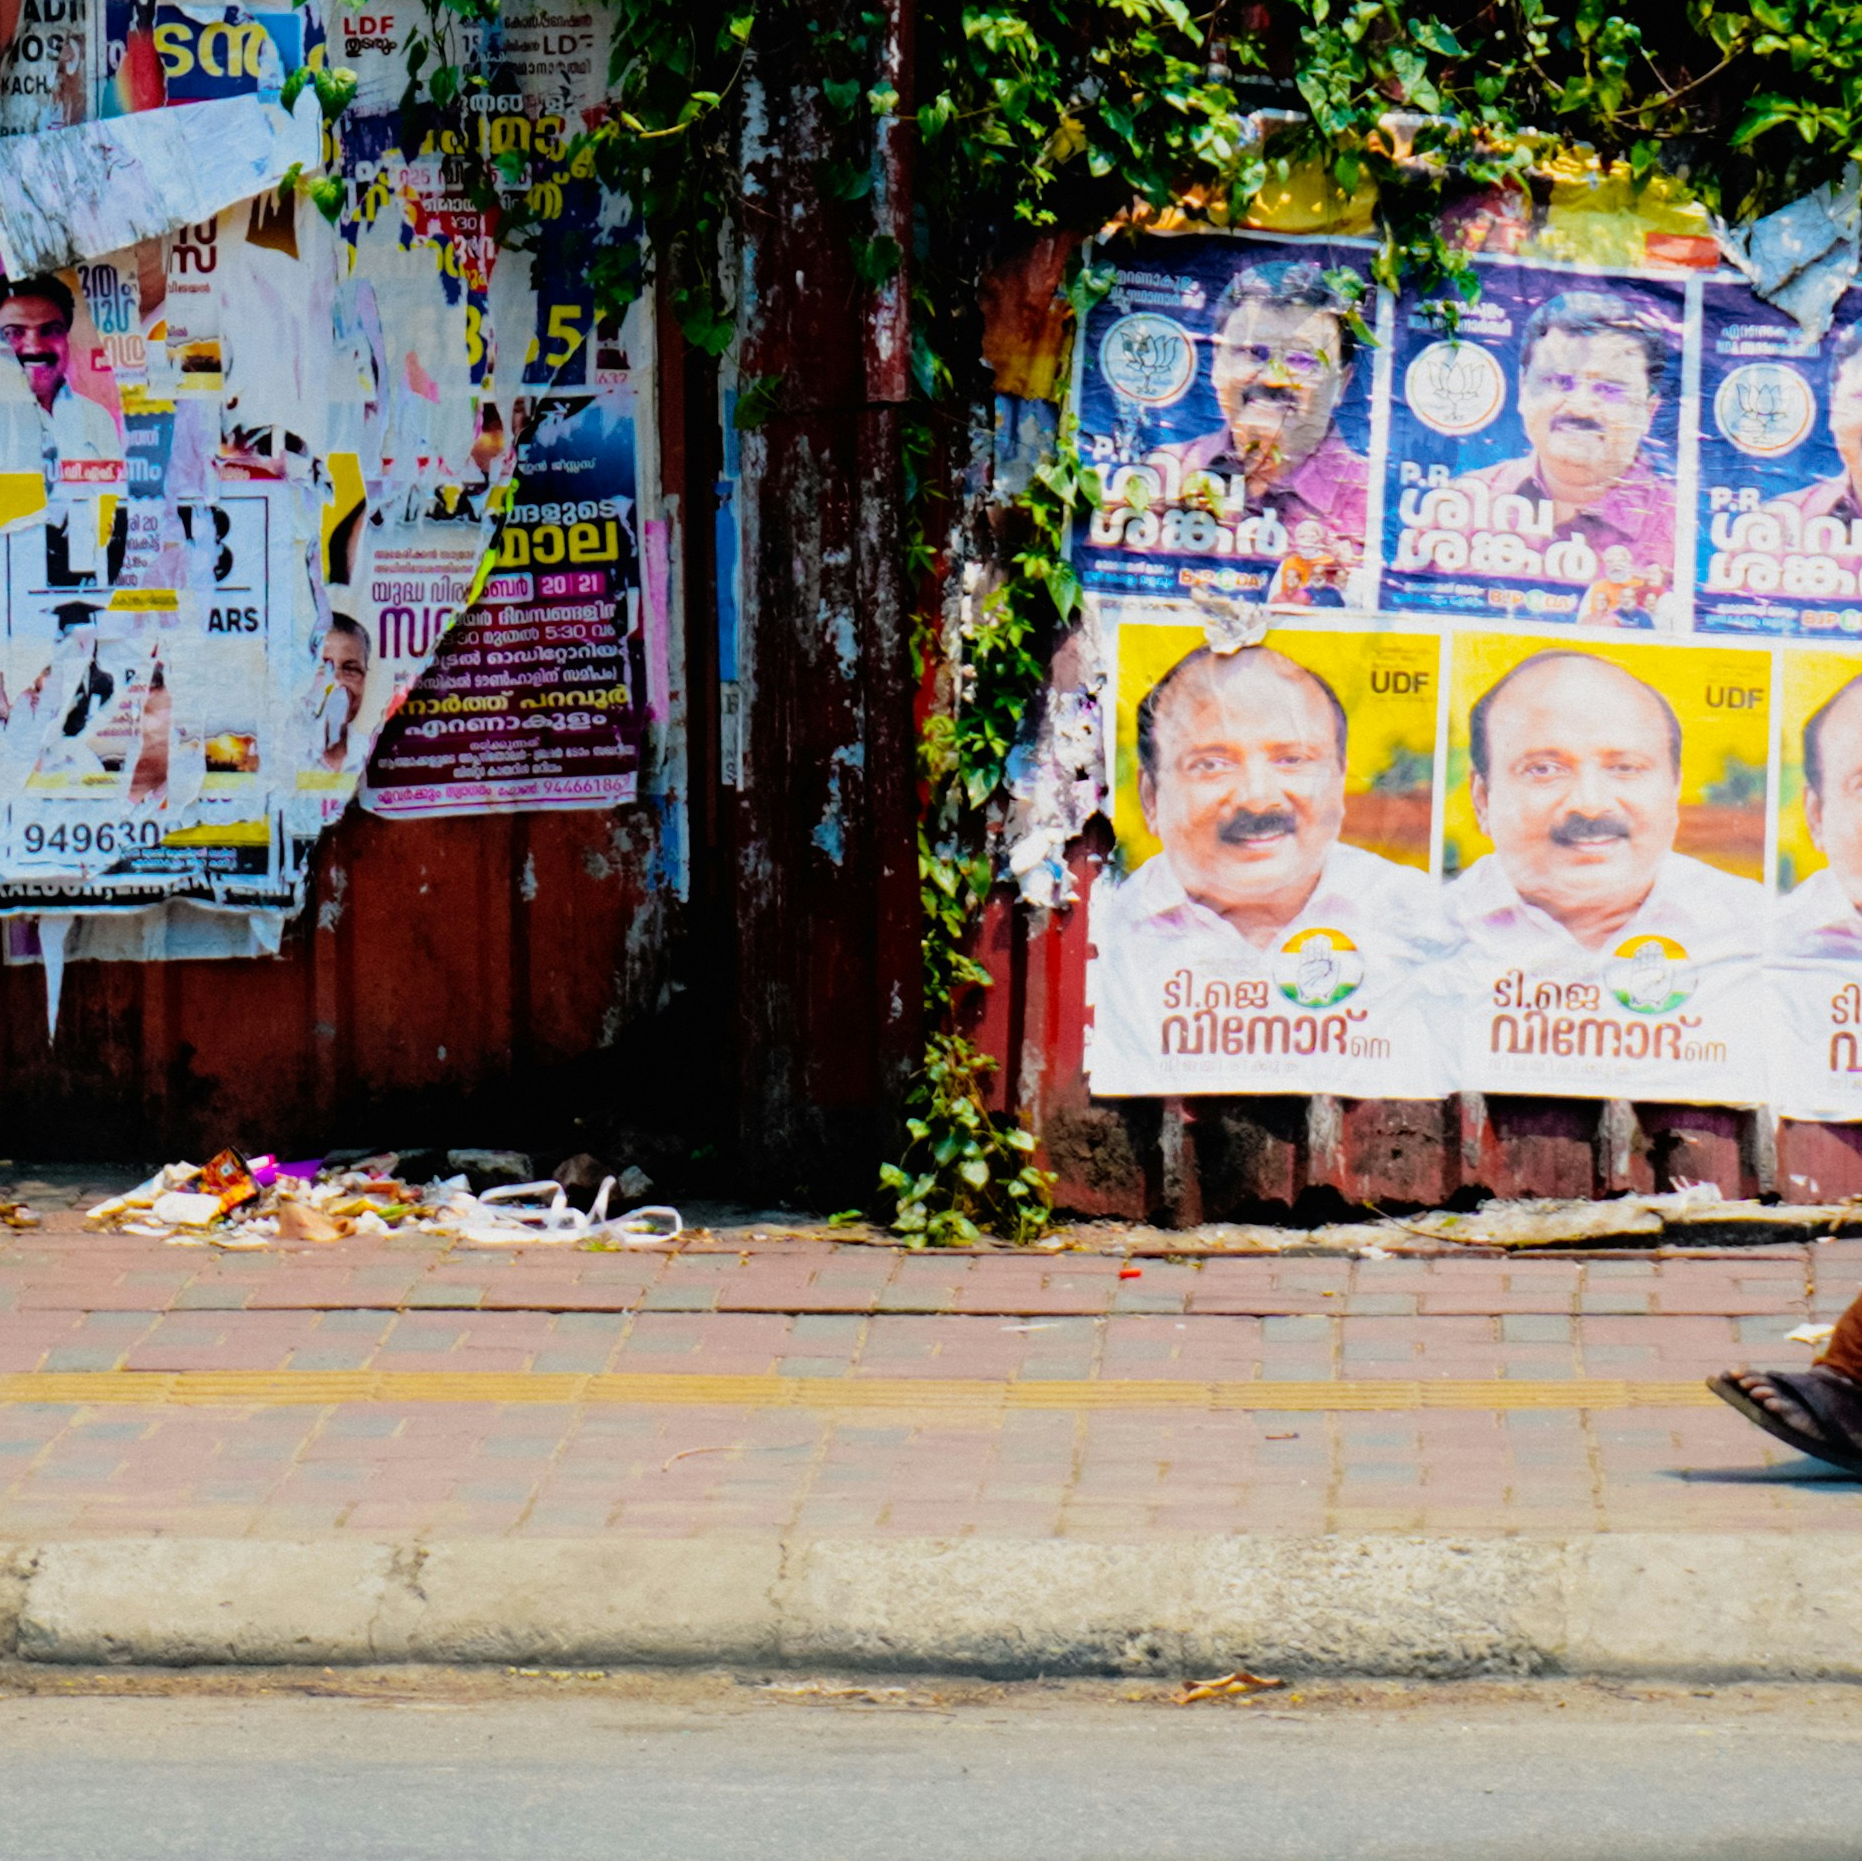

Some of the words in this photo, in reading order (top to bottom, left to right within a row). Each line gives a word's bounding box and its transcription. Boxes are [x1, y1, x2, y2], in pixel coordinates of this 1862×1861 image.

[344, 16, 394, 35] LDF
[345, 37, 397, 57] തുടരും
[1400, 477, 1554, 536] ശിവ
[1090, 507, 1288, 548] ശങ്കർ
[1396, 530, 1598, 578] ശങ്കർ
[542, 576, 566, 594] 20
[578, 574, 598, 592] 21
[545, 624, 586, 640] 5:30
[1371, 670, 1429, 695] UDF
[1705, 685, 1764, 710] UDF
[404, 712, 607, 738] എറണാകുളം
[25, 820, 184, 853] 949630
[1163, 969, 1269, 1009] ടി.ജെ
[1493, 969, 1600, 1011] ടി.ജെ
